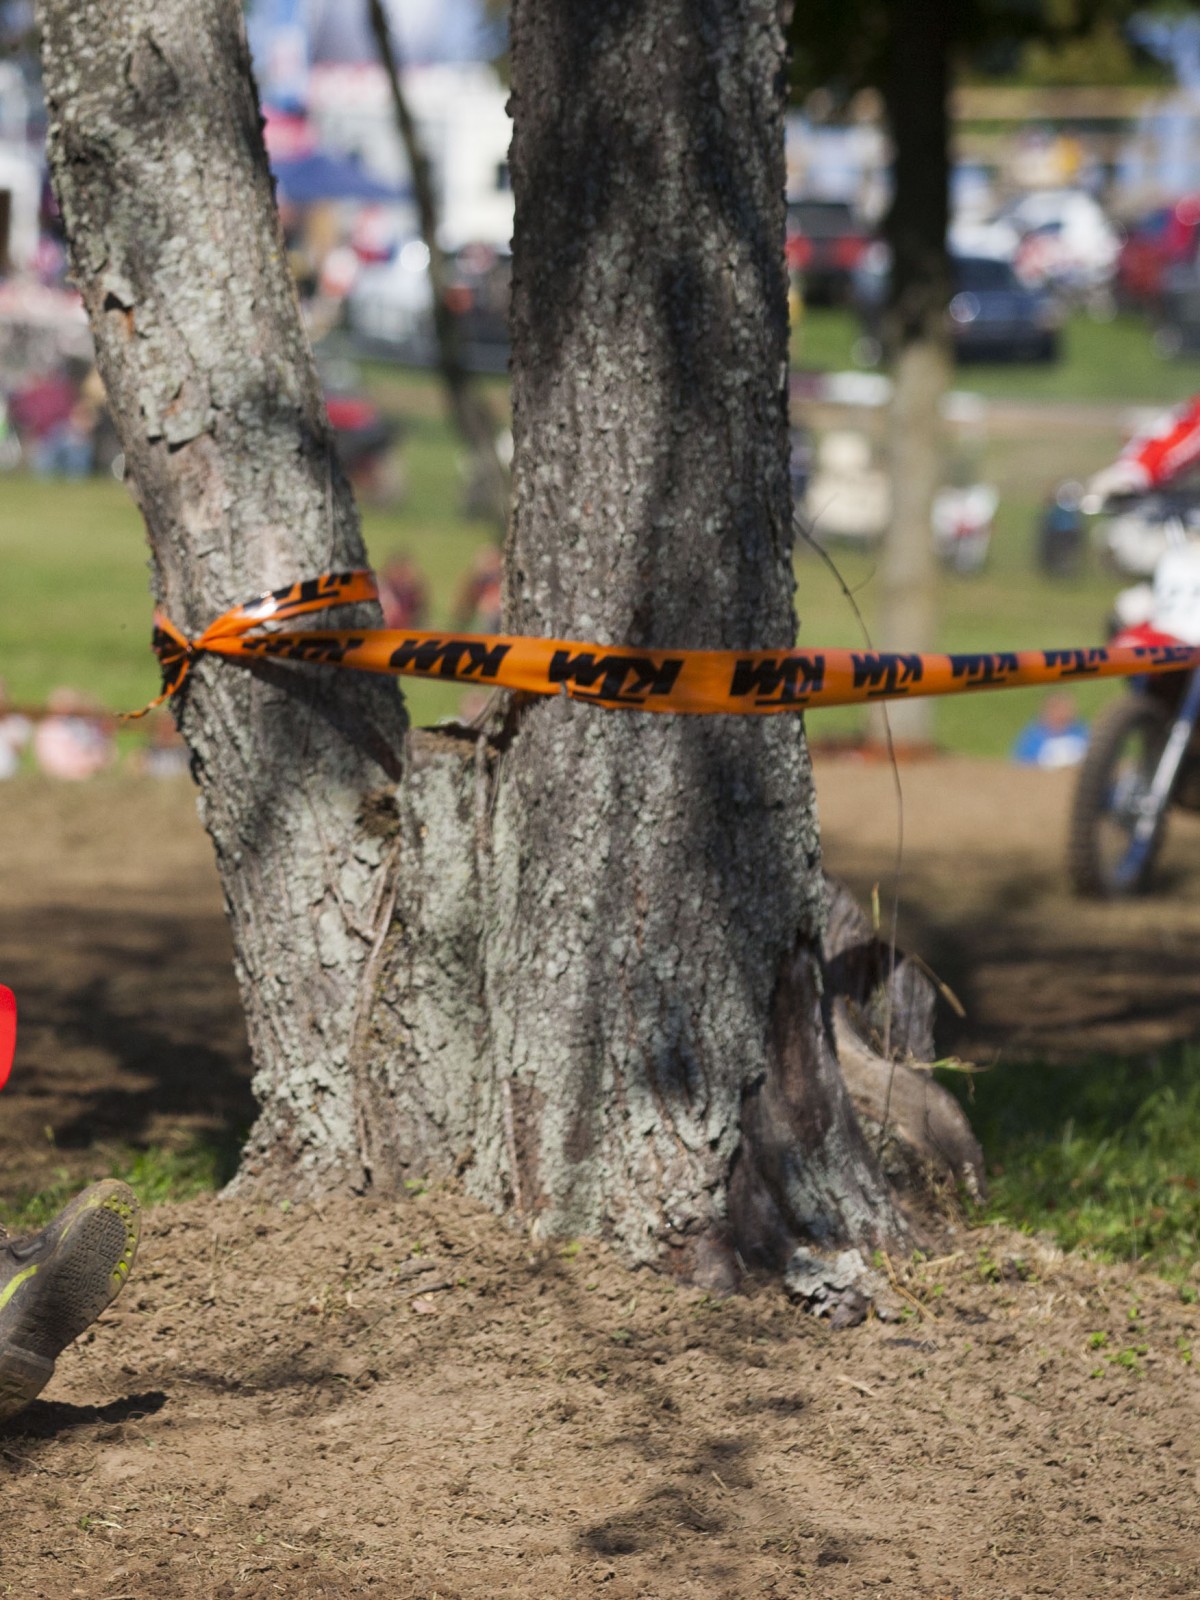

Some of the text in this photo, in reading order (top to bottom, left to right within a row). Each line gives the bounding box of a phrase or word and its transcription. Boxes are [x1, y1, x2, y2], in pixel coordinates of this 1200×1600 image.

[549, 650, 684, 703] KTM
[729, 656, 825, 706] KTM
[852, 654, 923, 696] KTM
[949, 654, 1018, 686] KTM
